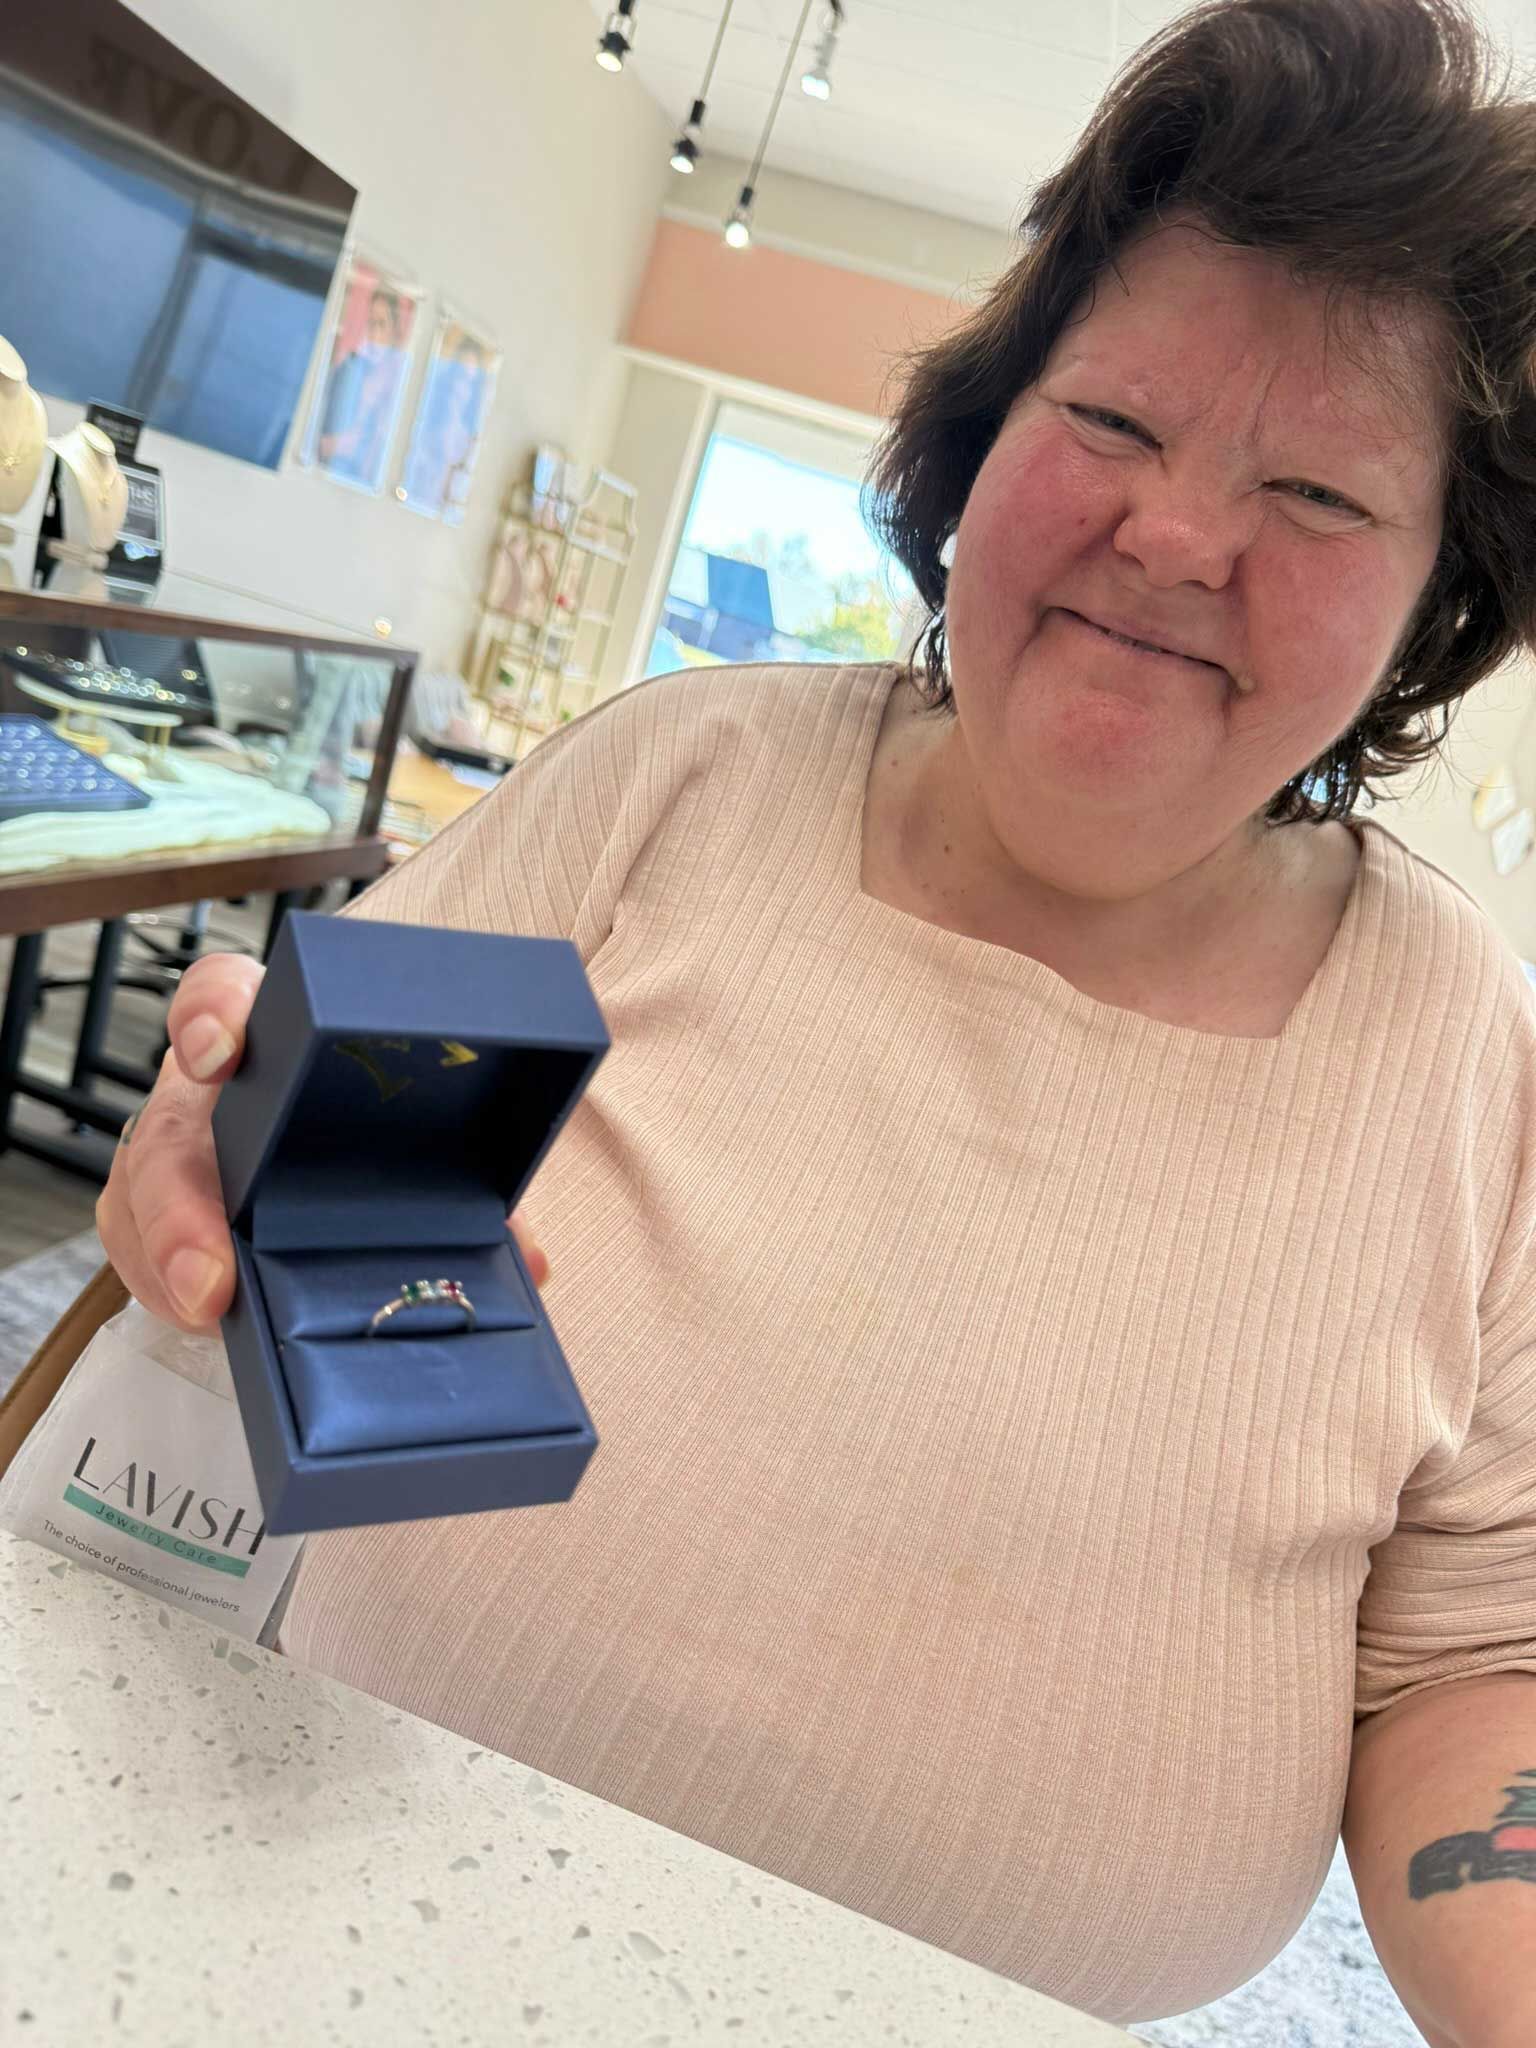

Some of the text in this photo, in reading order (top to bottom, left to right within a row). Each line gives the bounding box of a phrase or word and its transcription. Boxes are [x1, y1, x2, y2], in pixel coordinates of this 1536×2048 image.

[73, 1437, 265, 1555] LAVISH
[96, 1505, 217, 1564] Jewelry Care
[44, 1519, 240, 1613] The choice of professional jewelers
